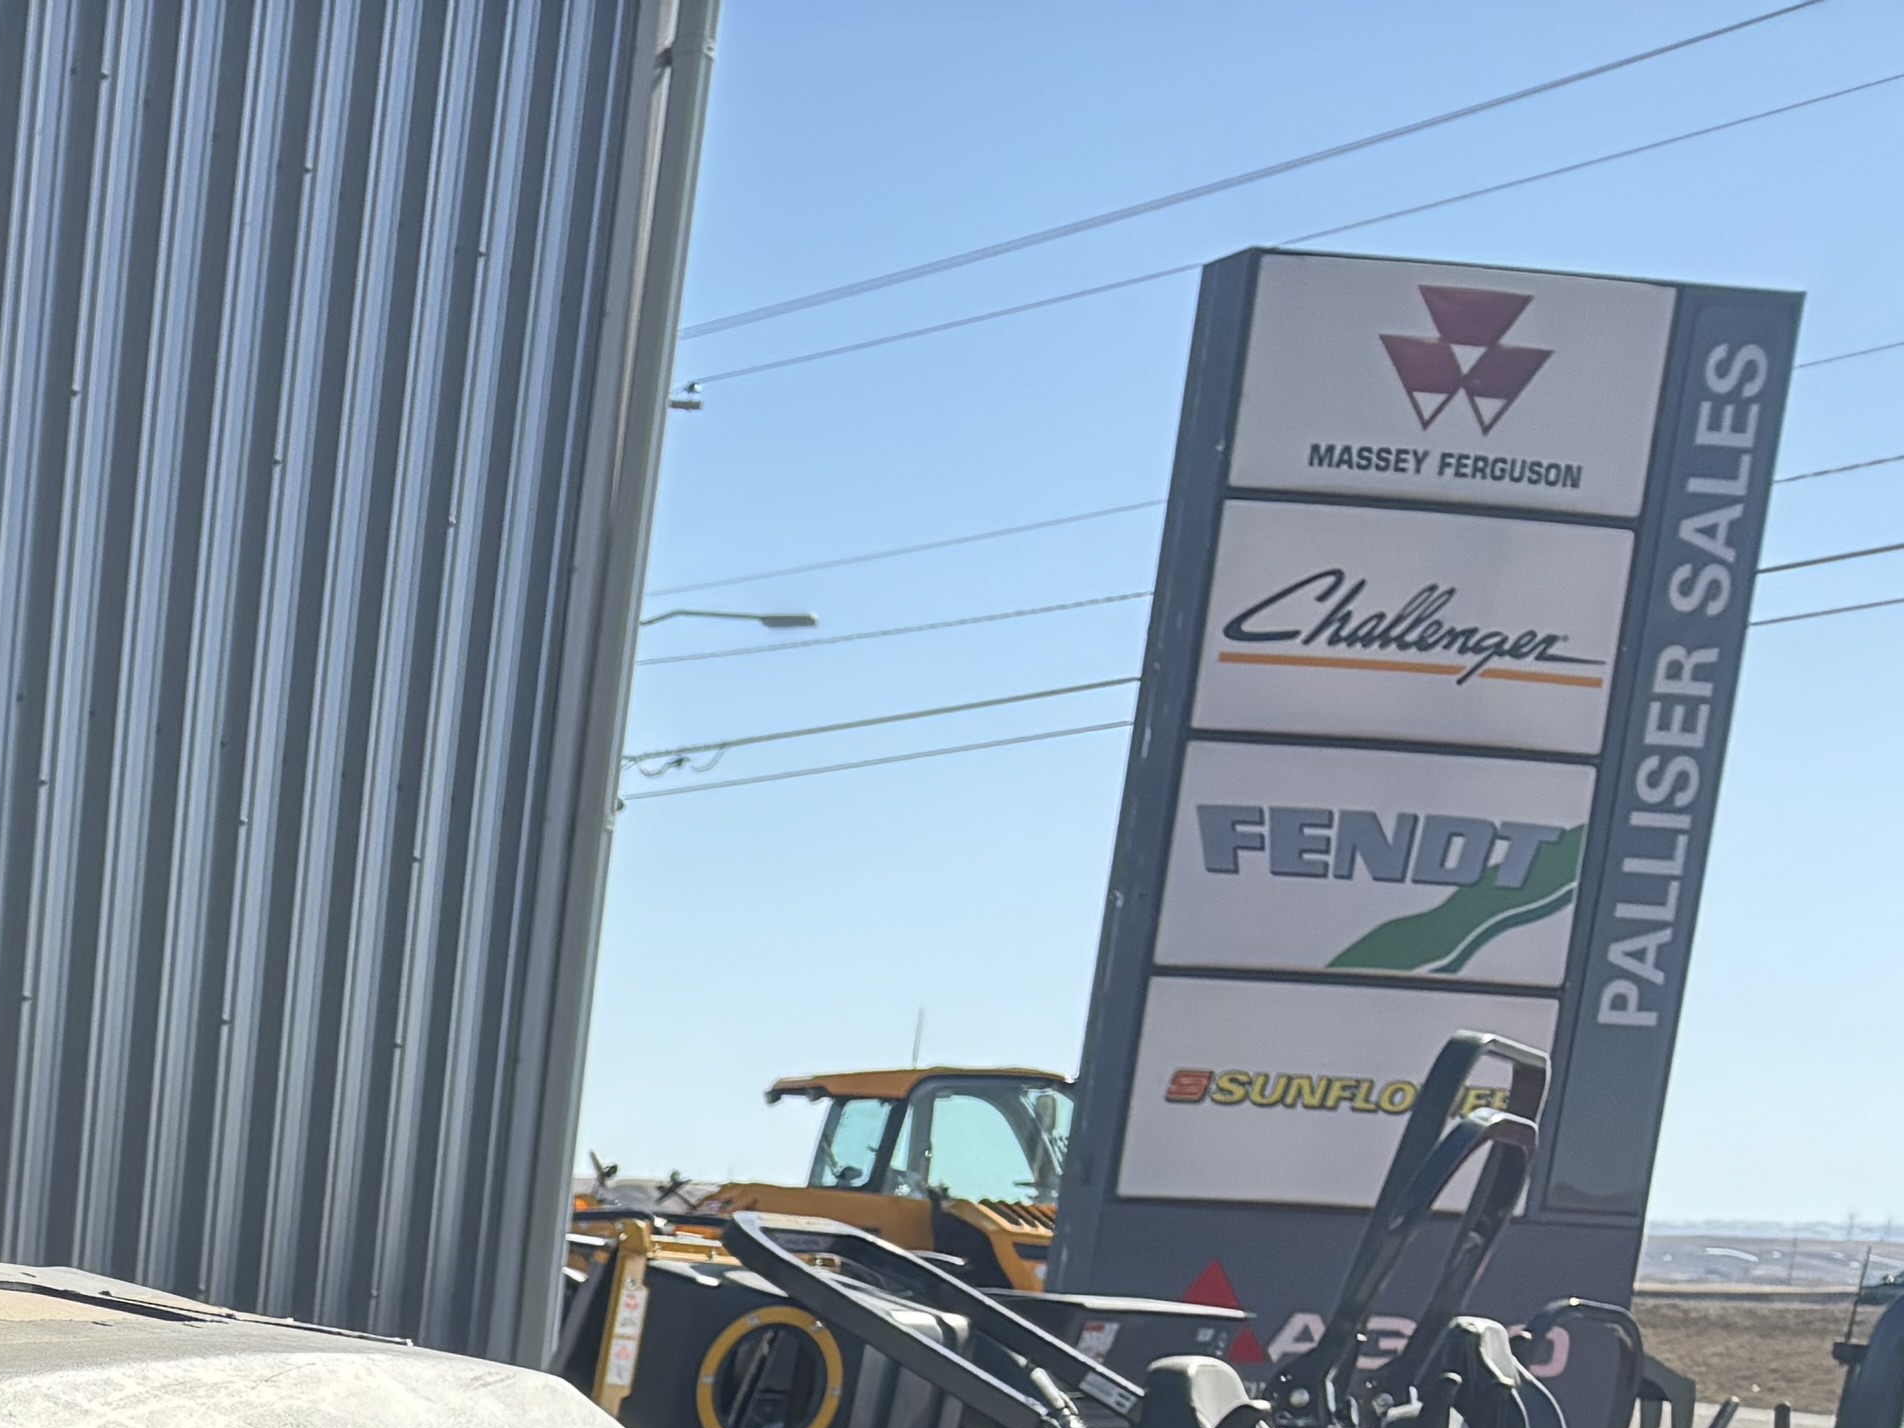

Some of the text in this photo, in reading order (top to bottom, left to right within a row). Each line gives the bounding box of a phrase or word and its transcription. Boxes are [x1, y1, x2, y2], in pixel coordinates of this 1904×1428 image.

[1308, 443, 1582, 489] MASSEY FERGUSON
[1222, 569, 1607, 685] Challenger
[1597, 341, 1768, 1027] PALLISER SALES
[1196, 804, 1564, 888] FENDT
